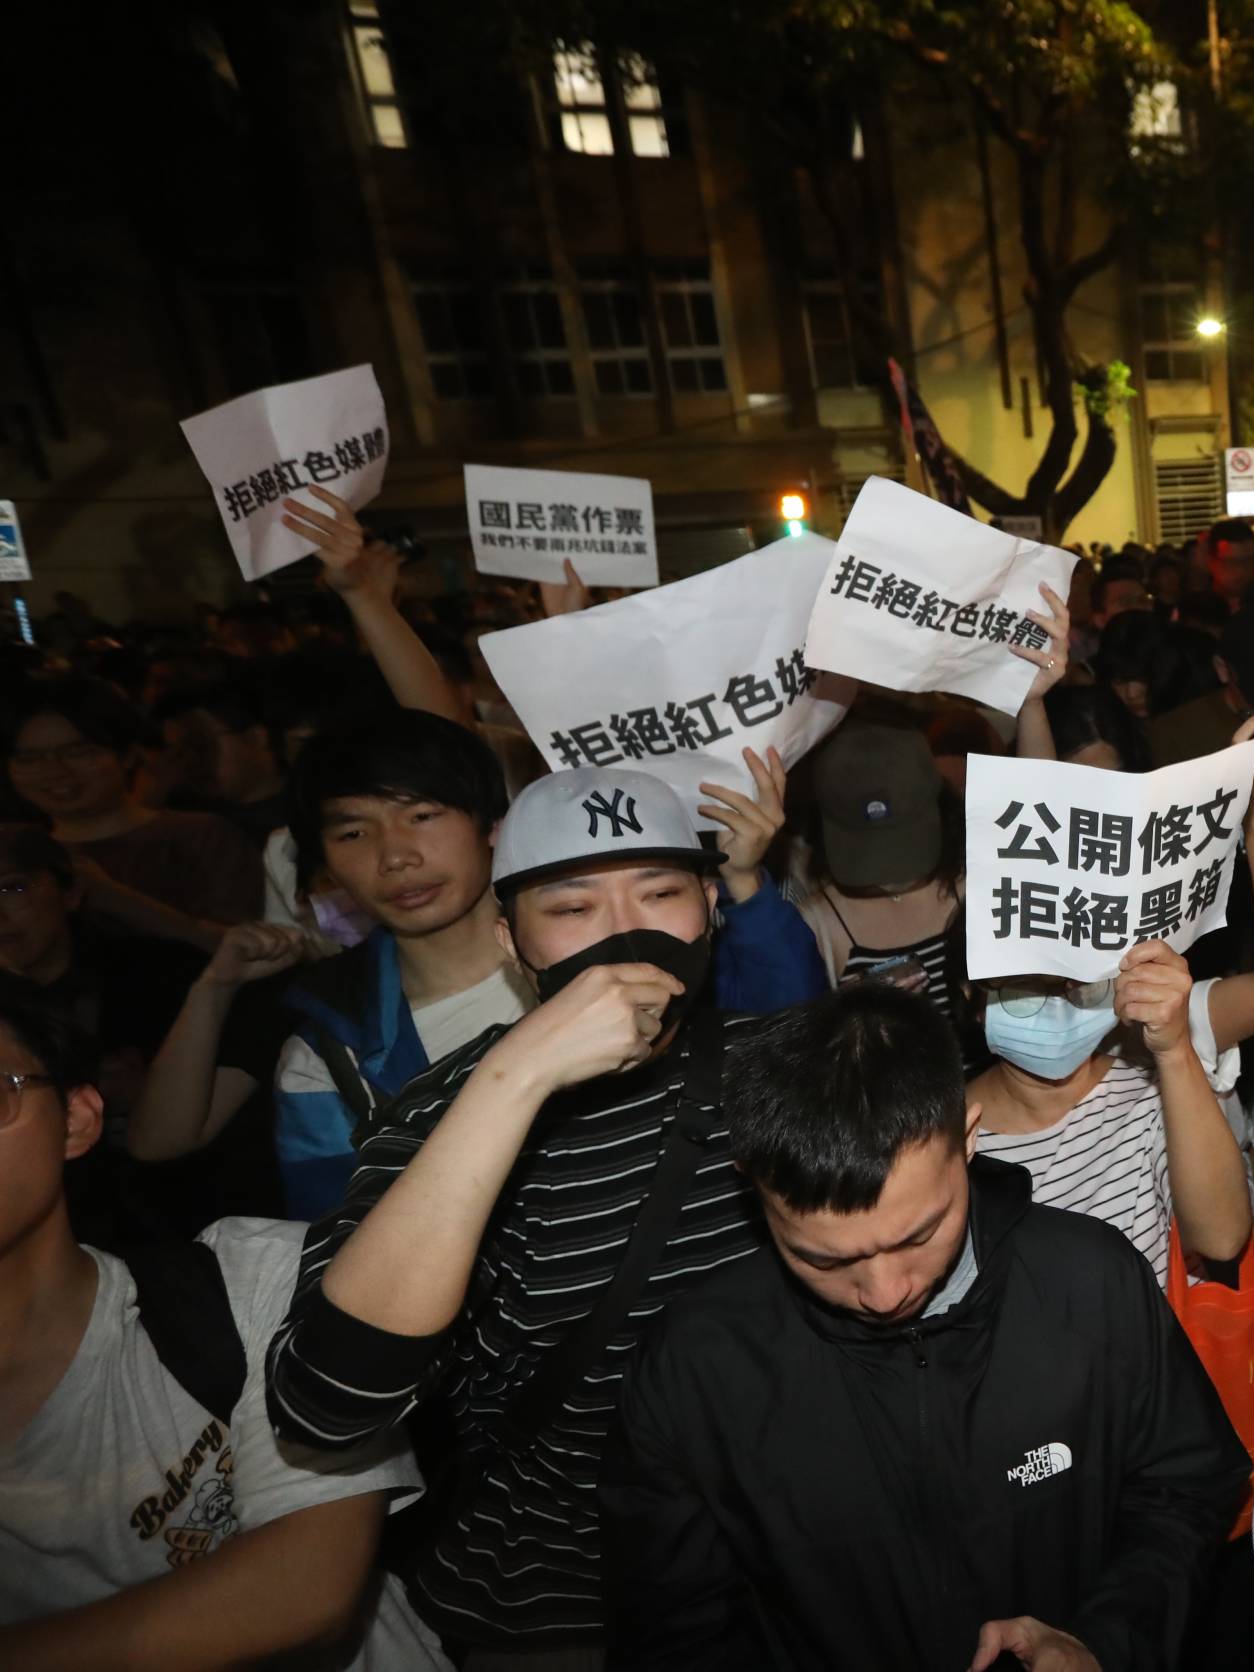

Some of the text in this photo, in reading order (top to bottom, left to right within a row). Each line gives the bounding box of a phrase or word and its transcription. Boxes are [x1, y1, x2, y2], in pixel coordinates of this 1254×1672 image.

[224, 426, 385, 522] 拒絕紅色媒體
[479, 499, 643, 535] 國民黨作票
[831, 555, 1049, 650] 拒絕紅色媒體
[550, 642, 825, 768] 拒絕紅色媒
[582, 788, 643, 838] NY
[994, 787, 1238, 877] 公開條文
[991, 857, 1226, 951] 拒絕黑箱
[130, 1420, 223, 1541] Bakery
[1007, 1455, 1051, 1481] NORTH
[1021, 1466, 1052, 1487] FACE
[1024, 1445, 1049, 1463] THE
